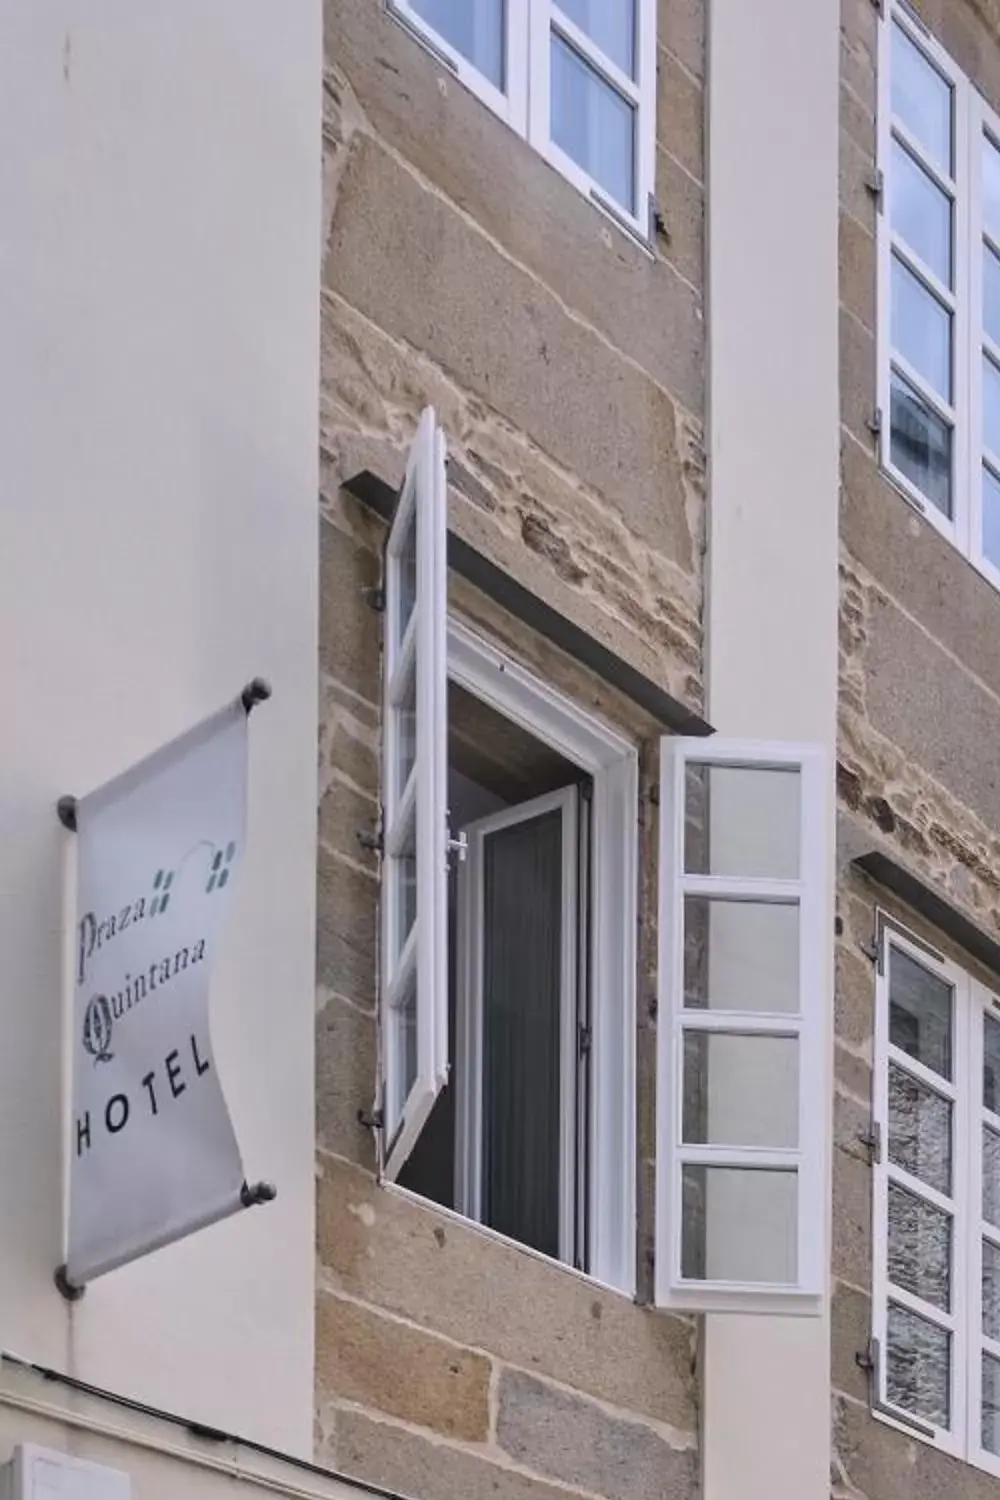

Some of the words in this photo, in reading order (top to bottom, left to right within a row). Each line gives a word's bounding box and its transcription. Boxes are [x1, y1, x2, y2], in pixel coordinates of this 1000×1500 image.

[77, 897, 146, 986] Praza
[83, 938, 206, 1069] Quintana
[76, 1032, 210, 1157] HOTEL
